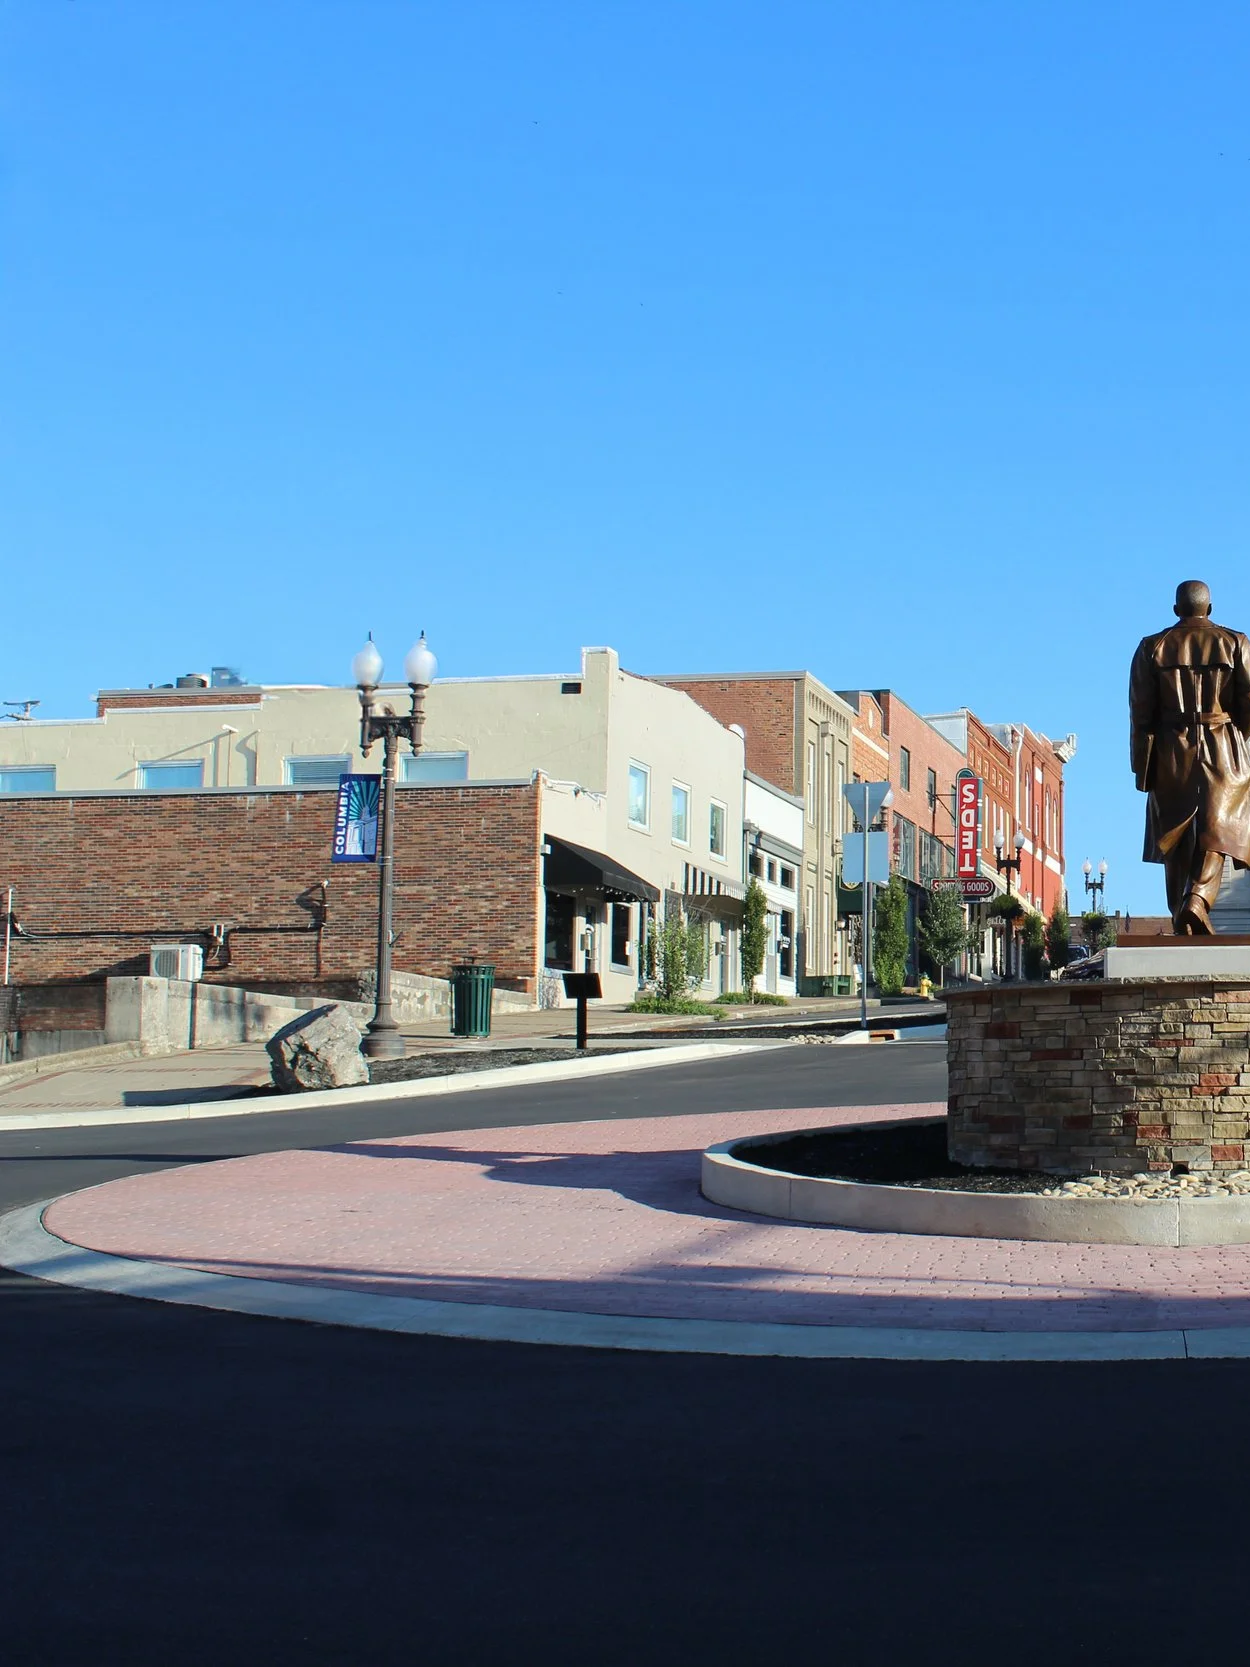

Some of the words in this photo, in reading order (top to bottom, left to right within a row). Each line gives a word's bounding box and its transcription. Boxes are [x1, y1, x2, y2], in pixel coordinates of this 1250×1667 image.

[335, 781, 350, 854] COLUMBIA
[960, 784, 975, 871] TED'S
[966, 882, 989, 892] GOODS
